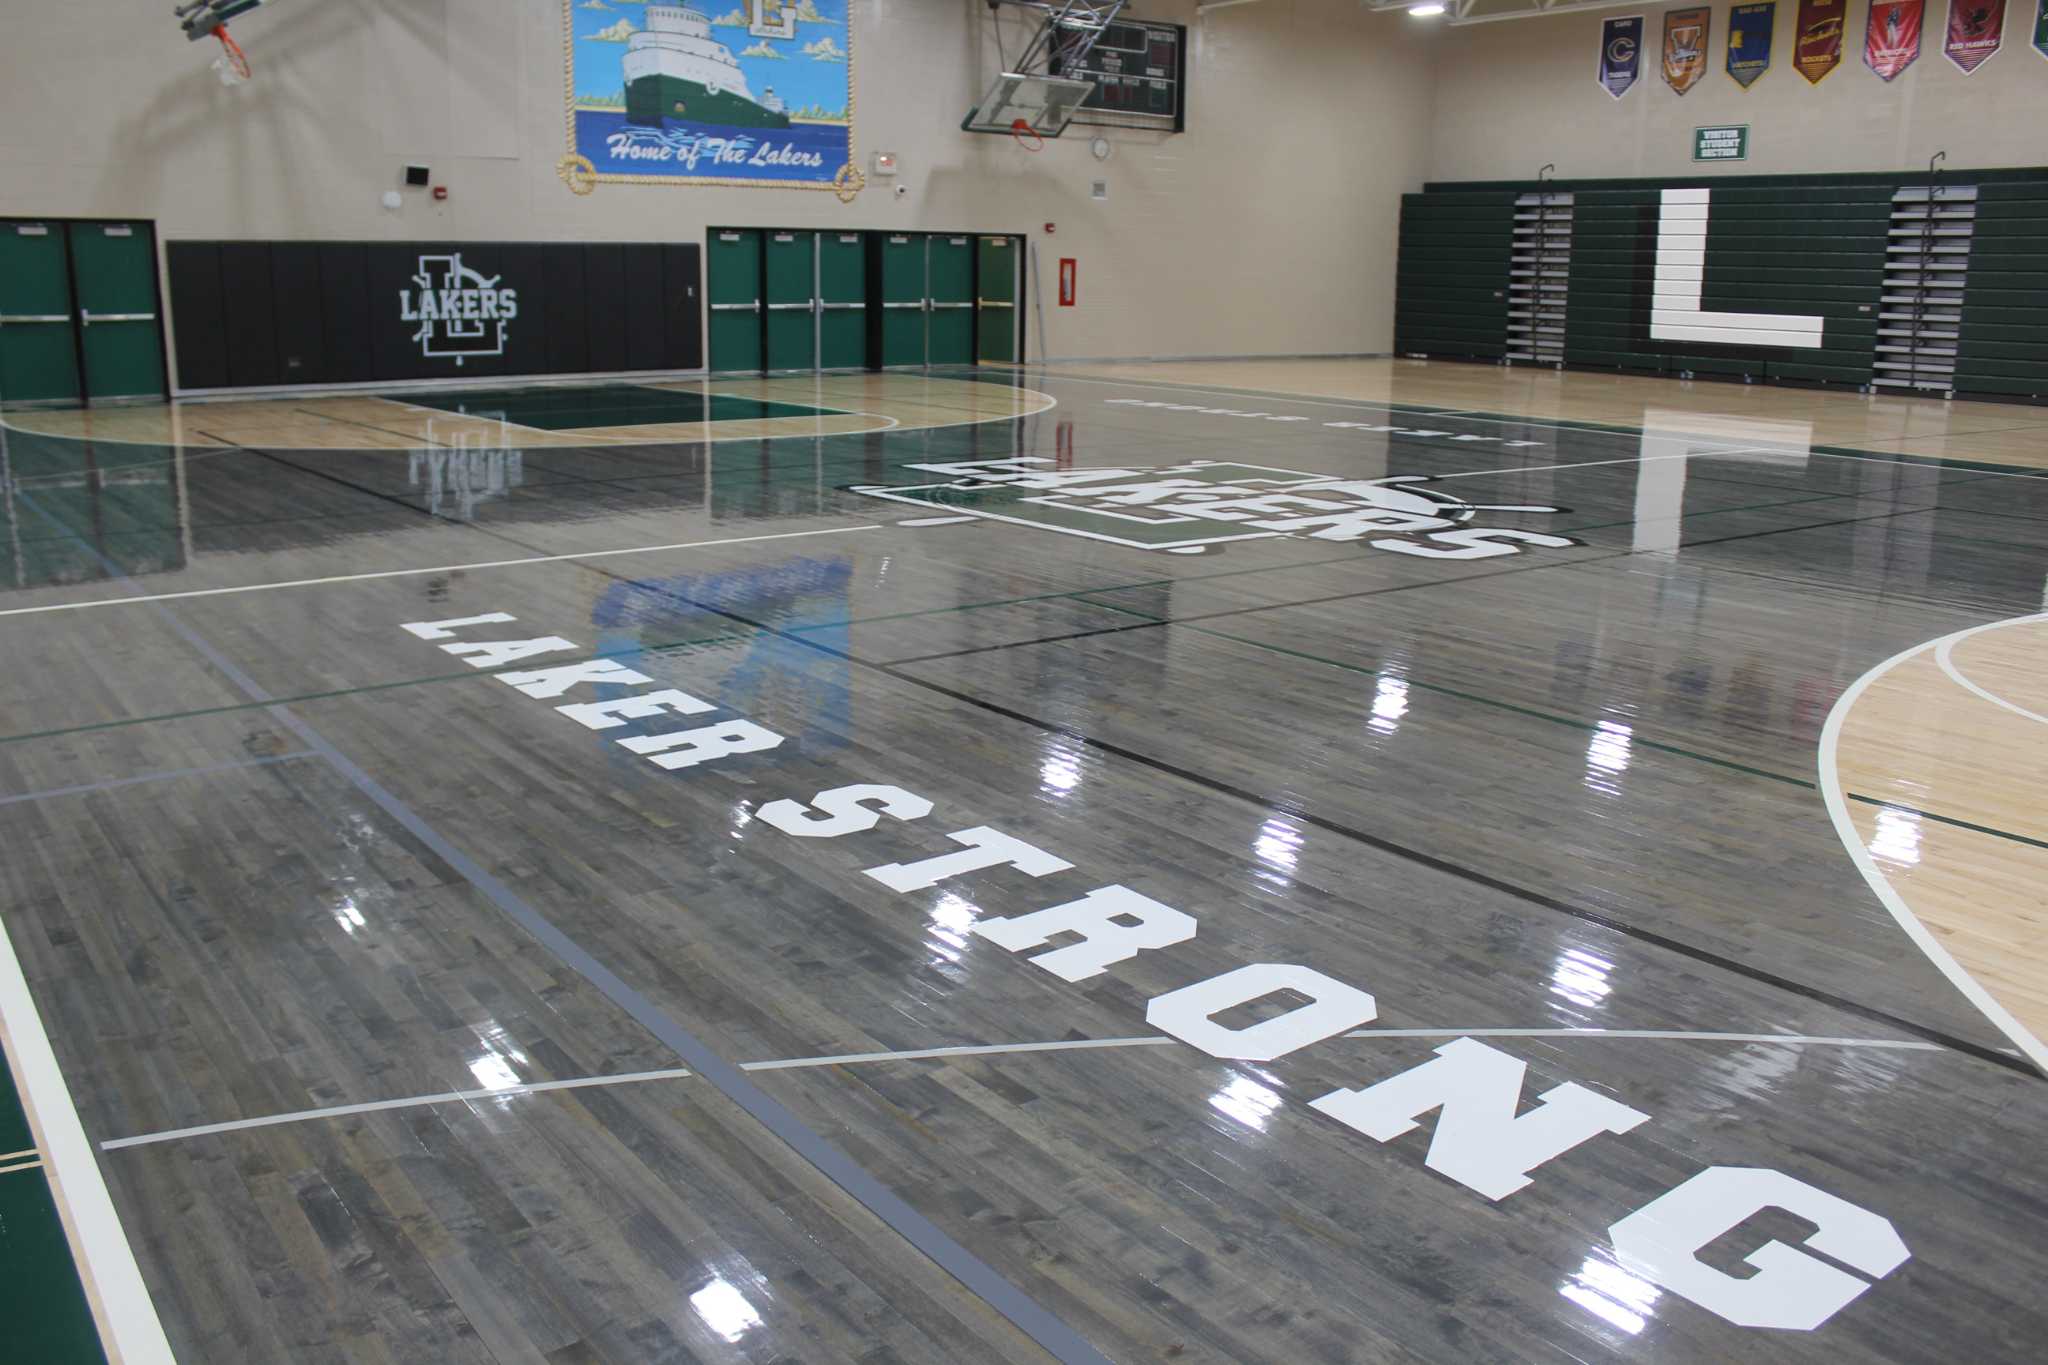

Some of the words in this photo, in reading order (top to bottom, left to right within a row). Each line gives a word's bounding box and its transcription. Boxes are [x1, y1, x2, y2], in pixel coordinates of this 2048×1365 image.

[606, 133, 672, 161] Home
[676, 138, 702, 171] of
[707, 137, 747, 164] The
[748, 141, 824, 168] Lakers
[399, 288, 517, 321] LAKERS
[902, 456, 1576, 561] LAKERS
[400, 612, 786, 770] LAKER
[754, 783, 1912, 1337] STRONG
